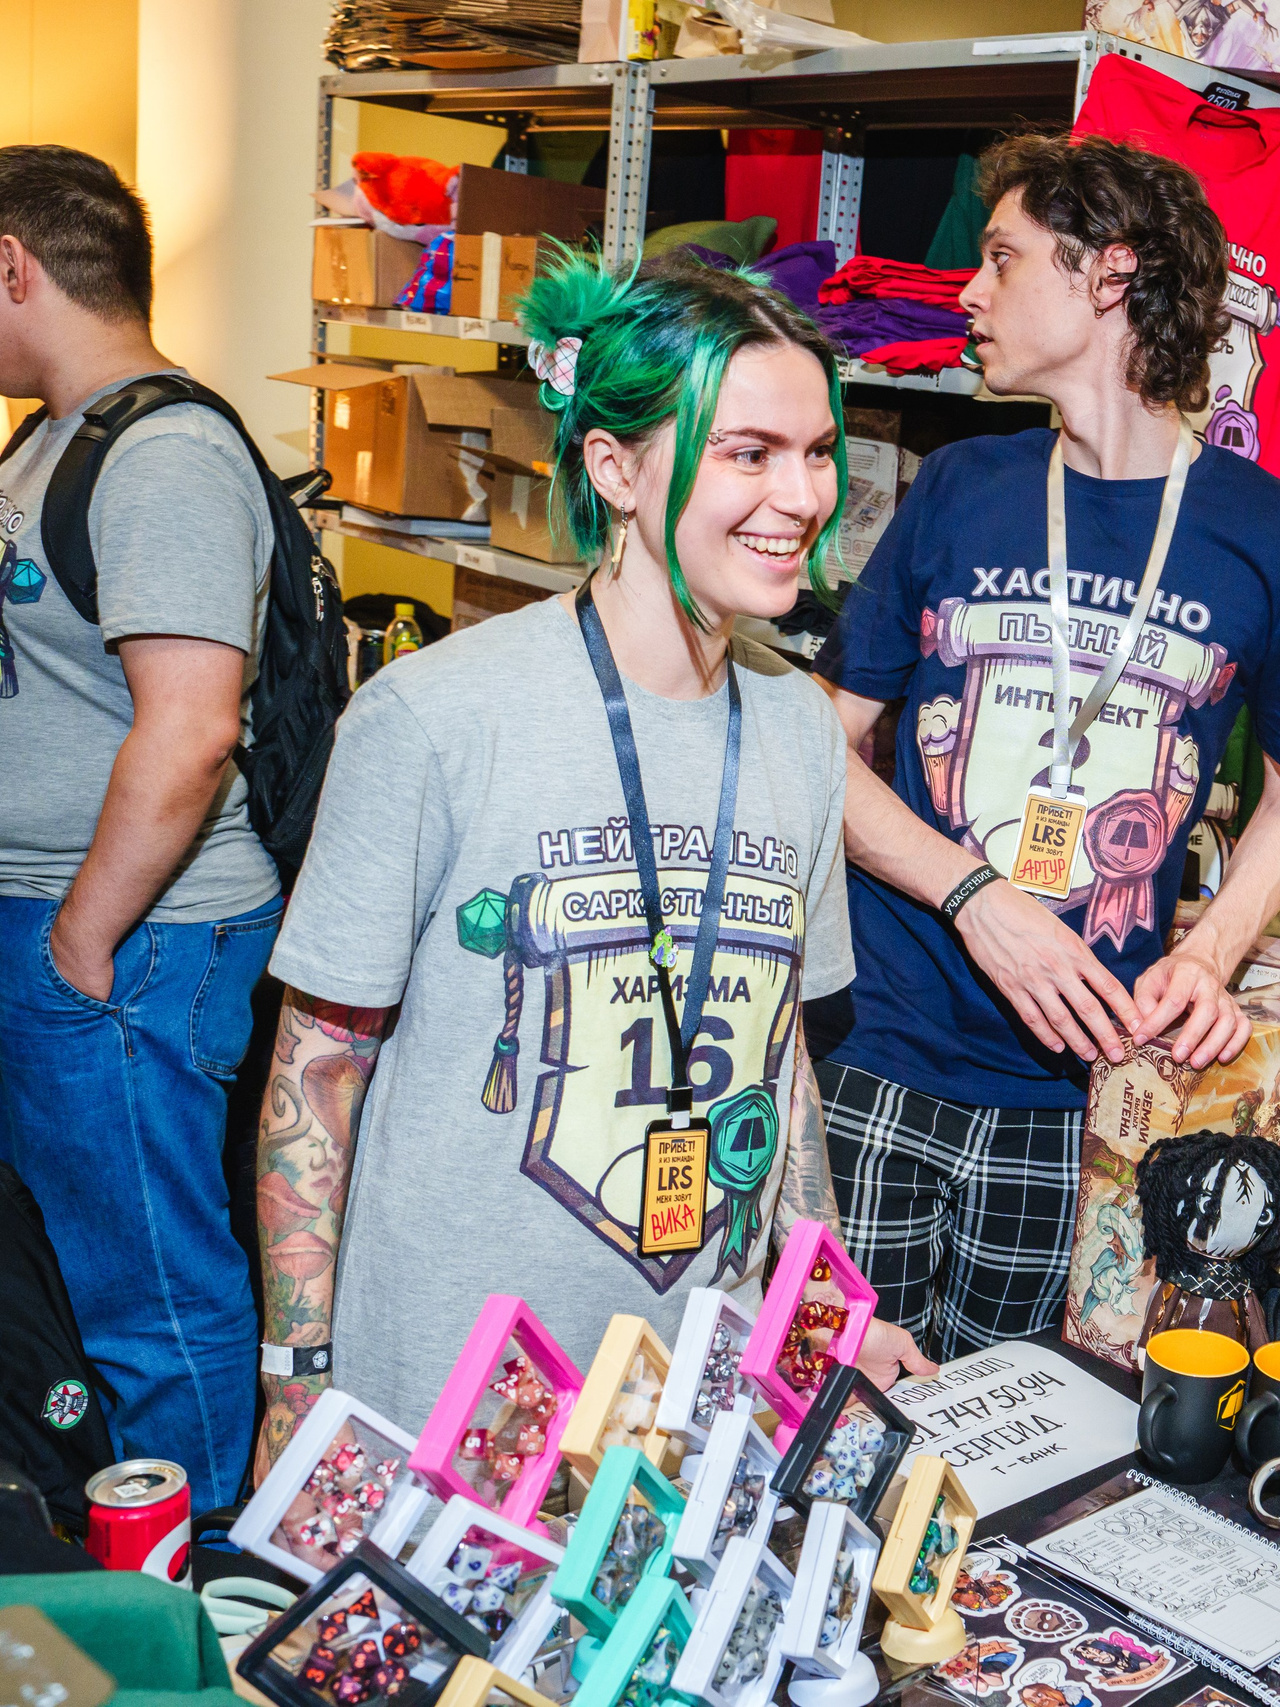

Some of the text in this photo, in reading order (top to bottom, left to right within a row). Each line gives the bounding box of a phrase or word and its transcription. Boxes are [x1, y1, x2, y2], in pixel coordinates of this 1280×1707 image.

[1226, 242, 1267, 278] ЧНО
[1036, 803, 1073, 820] ПРИВЕТ!
[1029, 843, 1064, 857] МЕНЯ ЗОВУТ
[1031, 822, 1067, 848] LRS
[1016, 858, 1066, 885] АРТУР
[944, 868, 995, 916] УЧАСТНИК
[613, 1014, 735, 1109] 16
[1119, 1078, 1135, 1139] ЛЕГЕНД
[1138, 1089, 1154, 1145] ЗЕМЛИ
[658, 1140, 696, 1155] ПРИВЕТ!
[657, 1164, 693, 1191] LRS
[656, 1193, 693, 1204] МЕНЯ ЗОВУТ
[650, 1203, 696, 1242] ВИКА
[944, 1356, 1016, 1387] STUDIO
[927, 1396, 992, 1430] 747
[986, 1384, 1028, 1410] 50
[1016, 1369, 1067, 1396] 94
[940, 1419, 1035, 1468] СЕРГЕЙ
